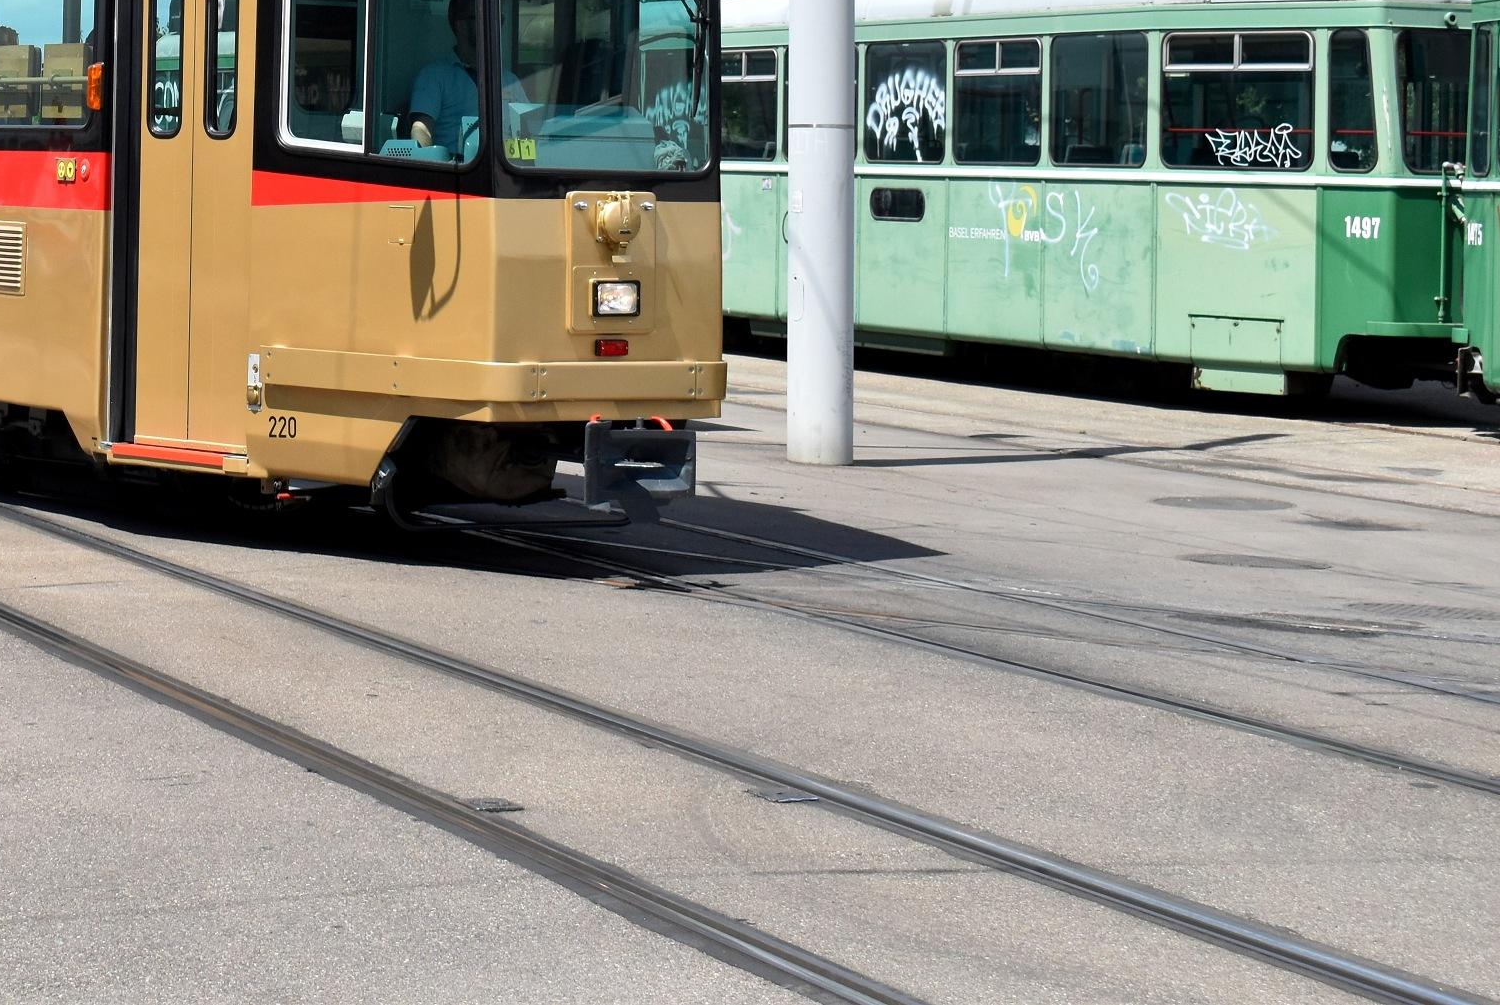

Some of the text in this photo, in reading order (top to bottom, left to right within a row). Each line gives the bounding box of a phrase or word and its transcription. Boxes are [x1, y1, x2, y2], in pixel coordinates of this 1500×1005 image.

[948, 226, 1006, 241] BASEL ERFAHREN
[1024, 230, 1040, 242] BVB
[1344, 215, 1381, 239] 1497
[1467, 222, 1483, 246] 1475
[268, 416, 297, 438] 220
